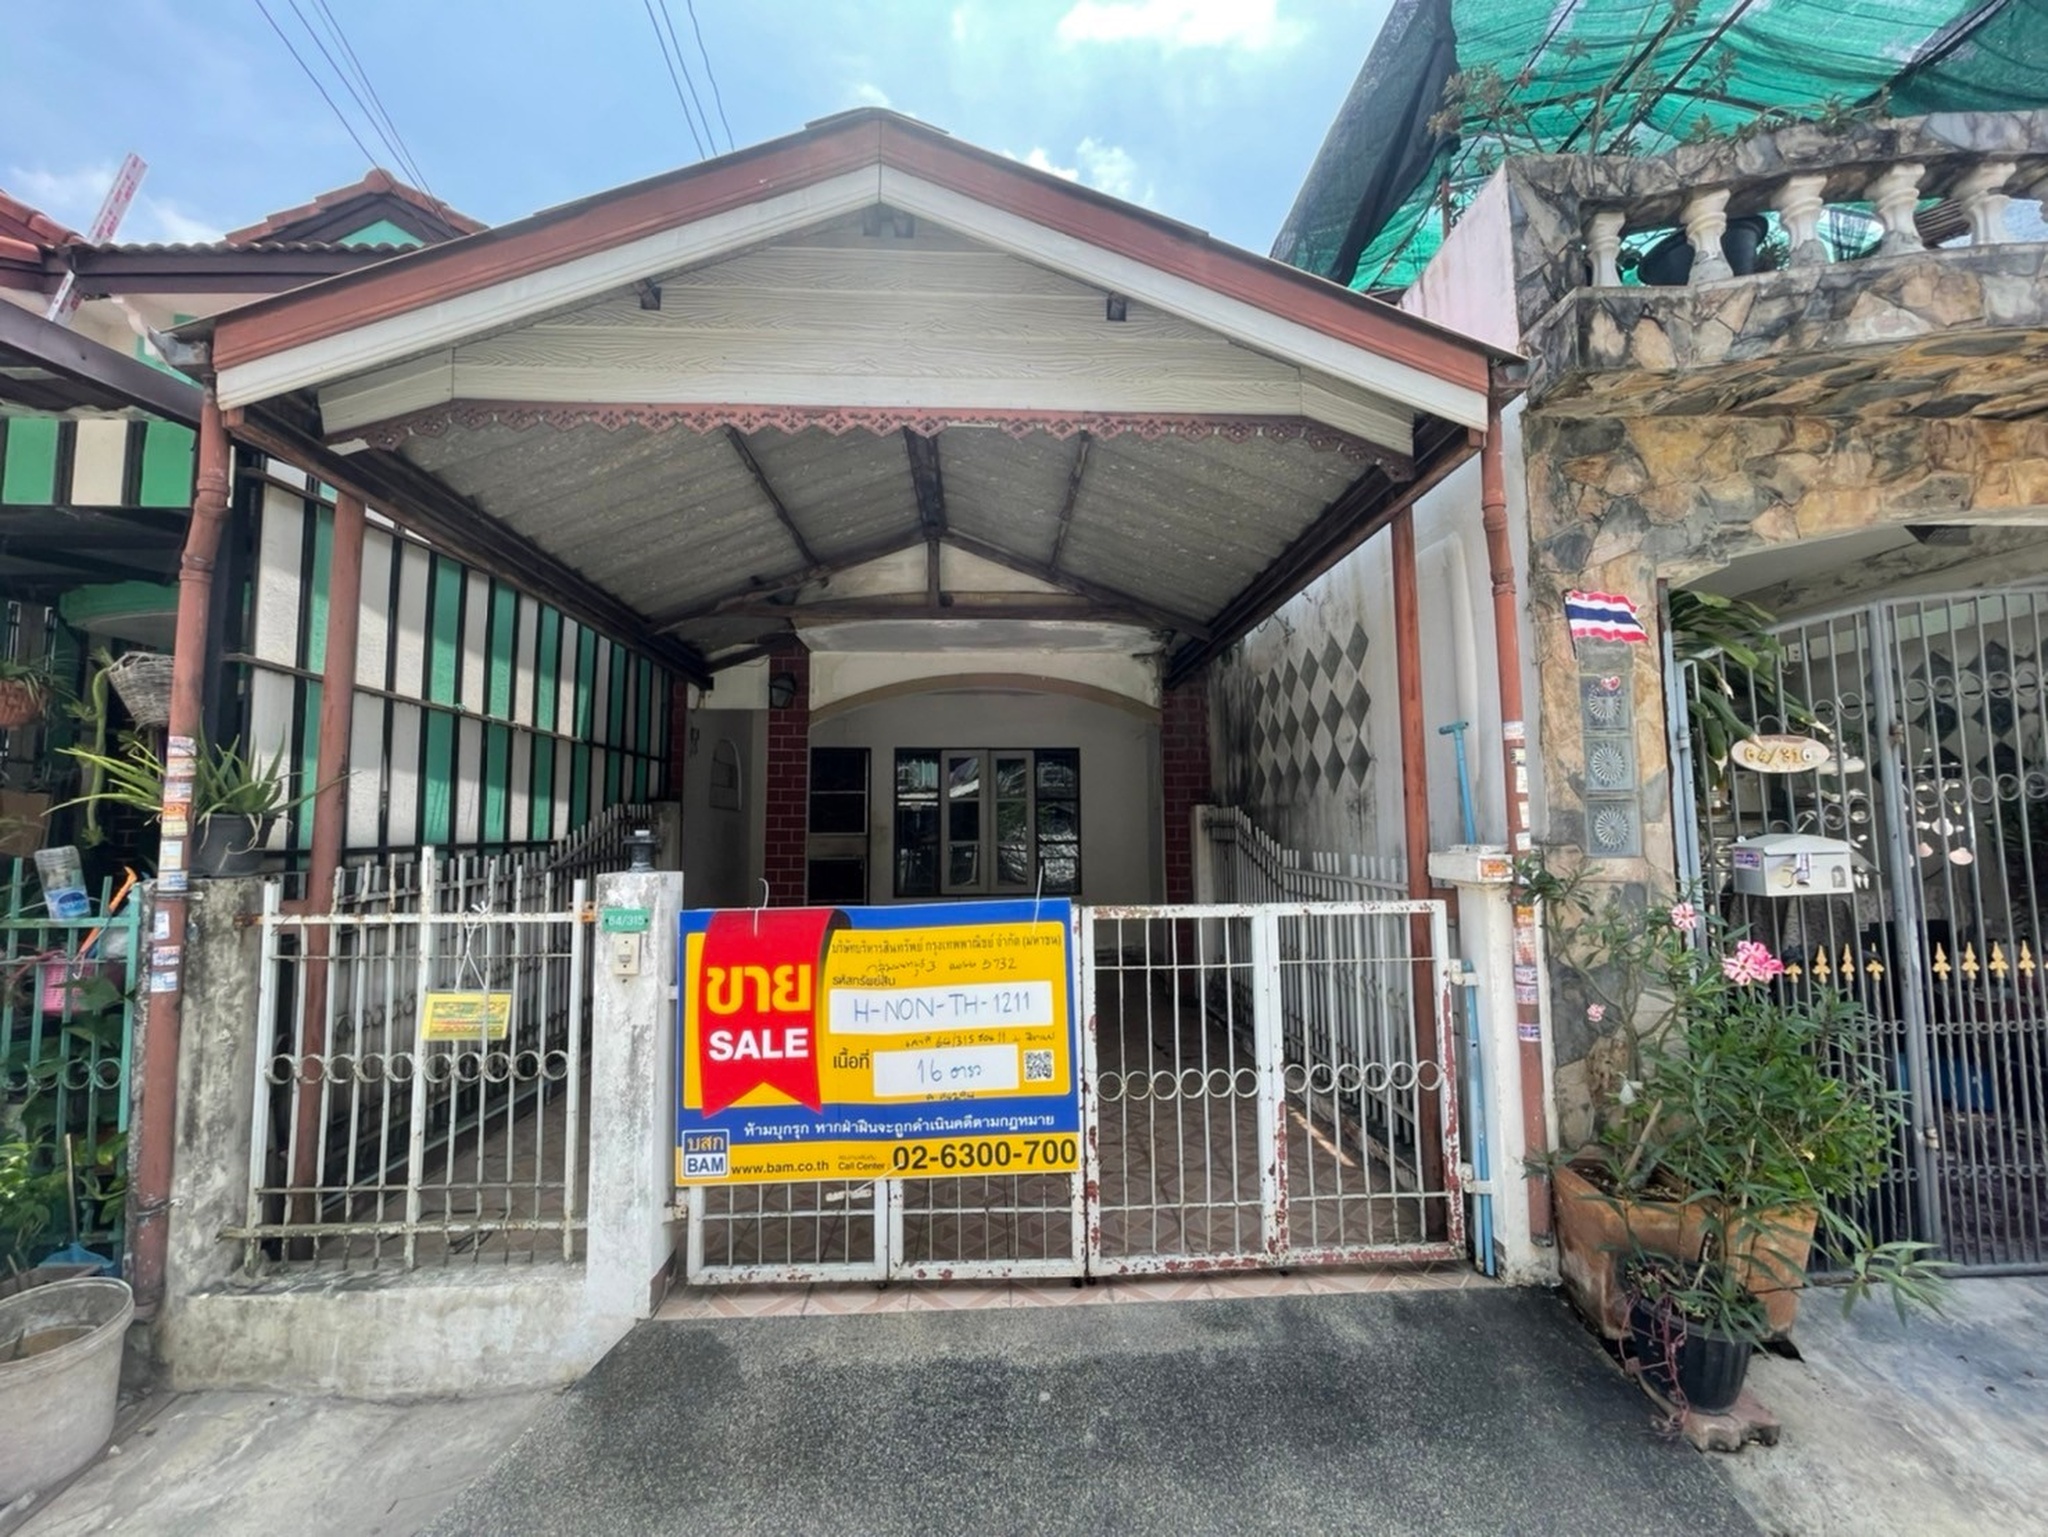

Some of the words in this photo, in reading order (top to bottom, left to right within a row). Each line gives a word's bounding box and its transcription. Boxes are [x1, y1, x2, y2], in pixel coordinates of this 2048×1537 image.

[608, 914, 645, 927] 64/315
[996, 933, 1021, 948] จำกัด
[706, 964, 811, 1015] ขาย
[853, 990, 1031, 1024] H-NON-TH-1211
[708, 1027, 810, 1062] SALE
[833, 1047, 870, 1070] เนื้อที่
[917, 1058, 943, 1084] 16
[743, 1121, 809, 1141] ห้ามบุกรุก
[686, 1135, 725, 1153] บสก
[838, 1160, 855, 1171] Call
[856, 1160, 886, 1171] Center
[892, 1138, 1077, 1171] 02-6300-700
[686, 1156, 725, 1174] BAM
[731, 1159, 830, 1175] www.bam.co.th
